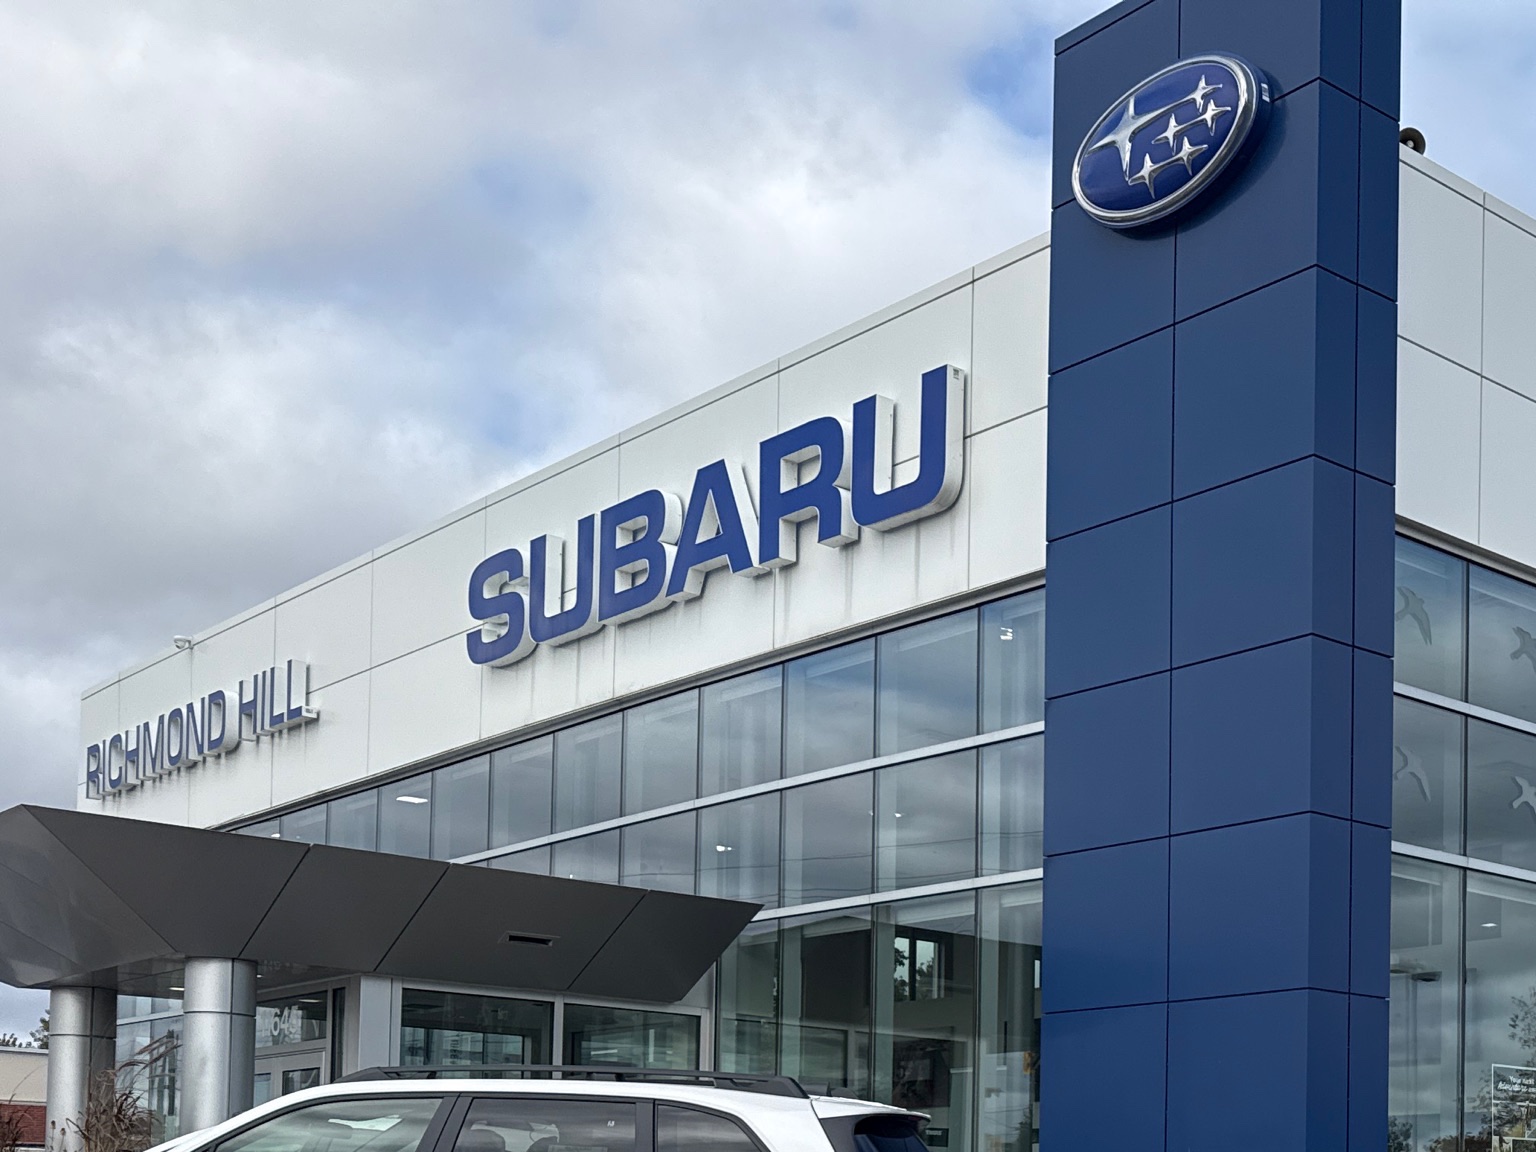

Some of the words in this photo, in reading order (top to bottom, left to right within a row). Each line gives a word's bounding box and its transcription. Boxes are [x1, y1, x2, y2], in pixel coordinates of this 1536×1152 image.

[466, 364, 950, 666] SUBARU
[86, 689, 227, 800] RICHMOND
[239, 659, 305, 741] HILL
